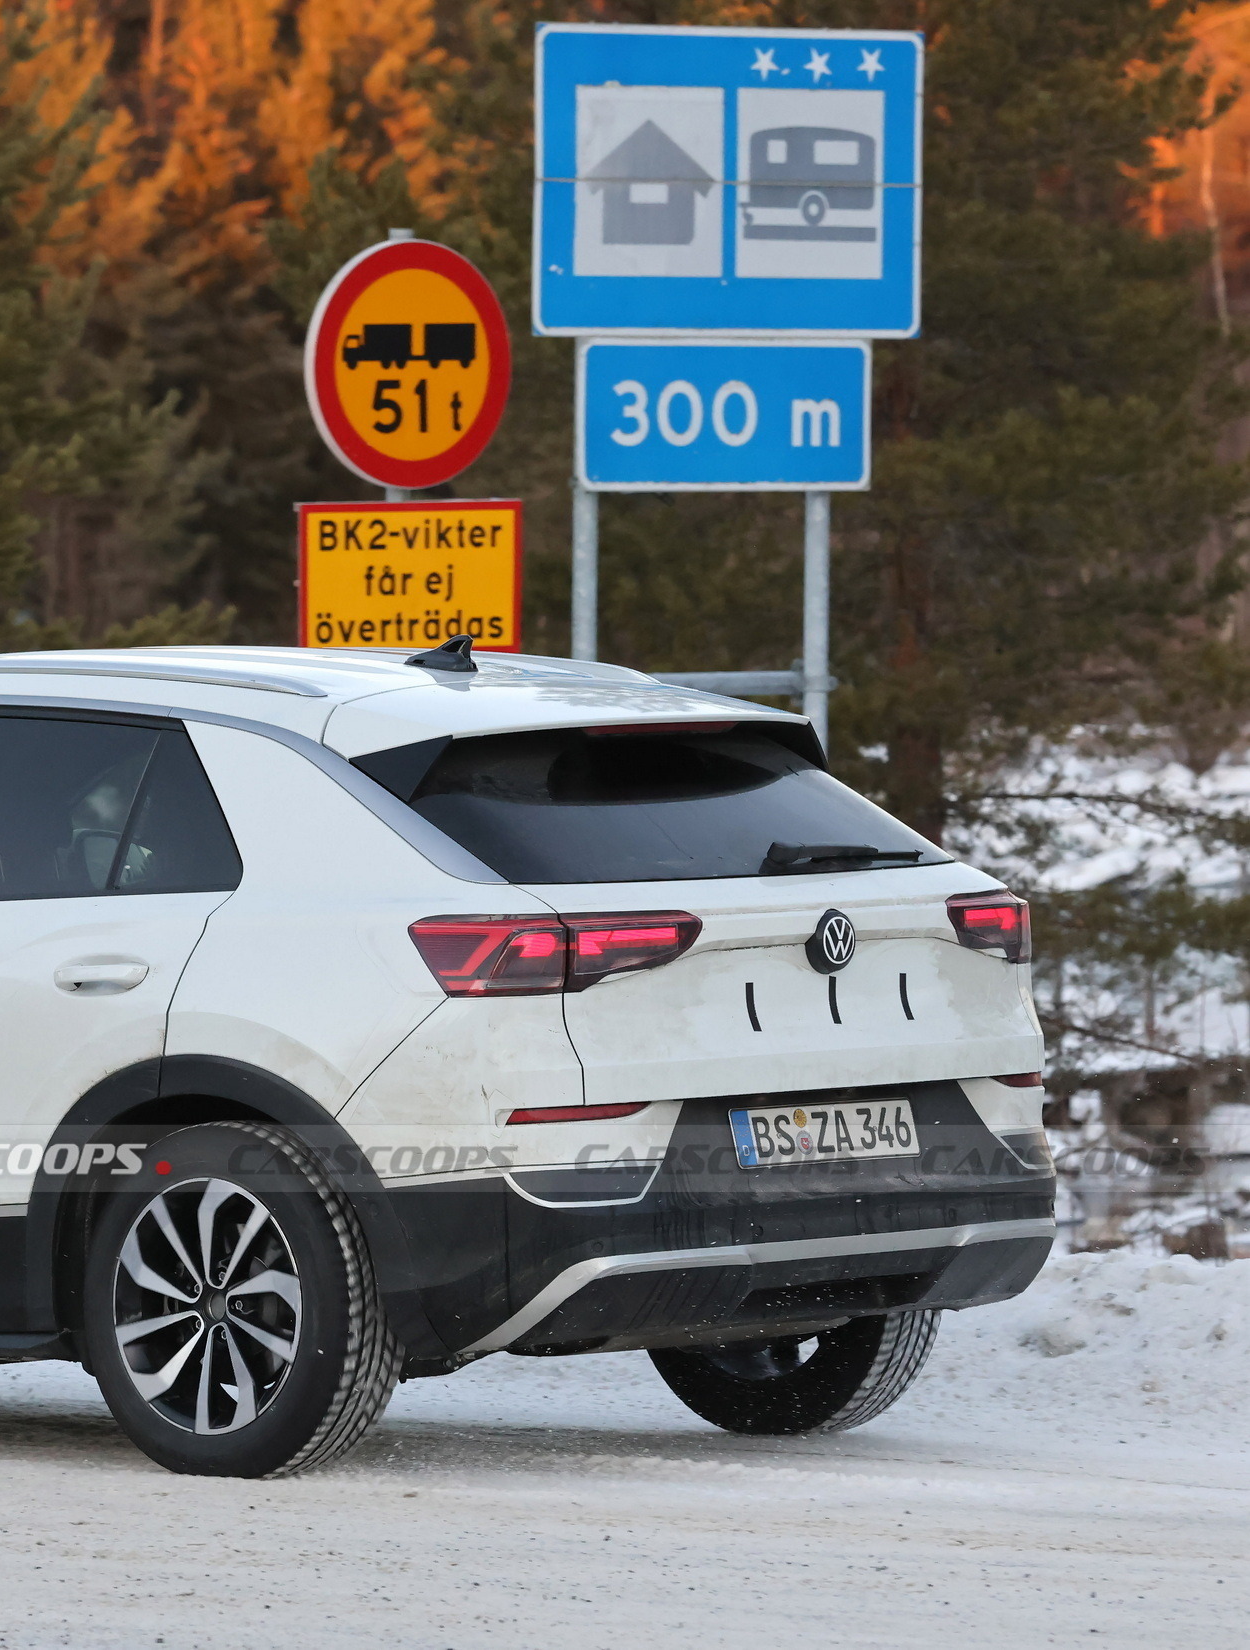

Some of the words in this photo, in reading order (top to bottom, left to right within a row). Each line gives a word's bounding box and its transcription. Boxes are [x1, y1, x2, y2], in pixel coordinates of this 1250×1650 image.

[372, 379, 428, 434] 51
[450, 391, 462, 431] t
[610, 379, 758, 447] 300
[791, 398, 841, 447] m
[319, 518, 502, 551] BK2-vikter
[364, 565, 413, 596] får
[425, 564, 454, 602] ej
[315, 609, 504, 643] överträdas
[751, 1114, 796, 1158] BS
[811, 1110, 855, 1153] ZA
[856, 1106, 912, 1150] 346
